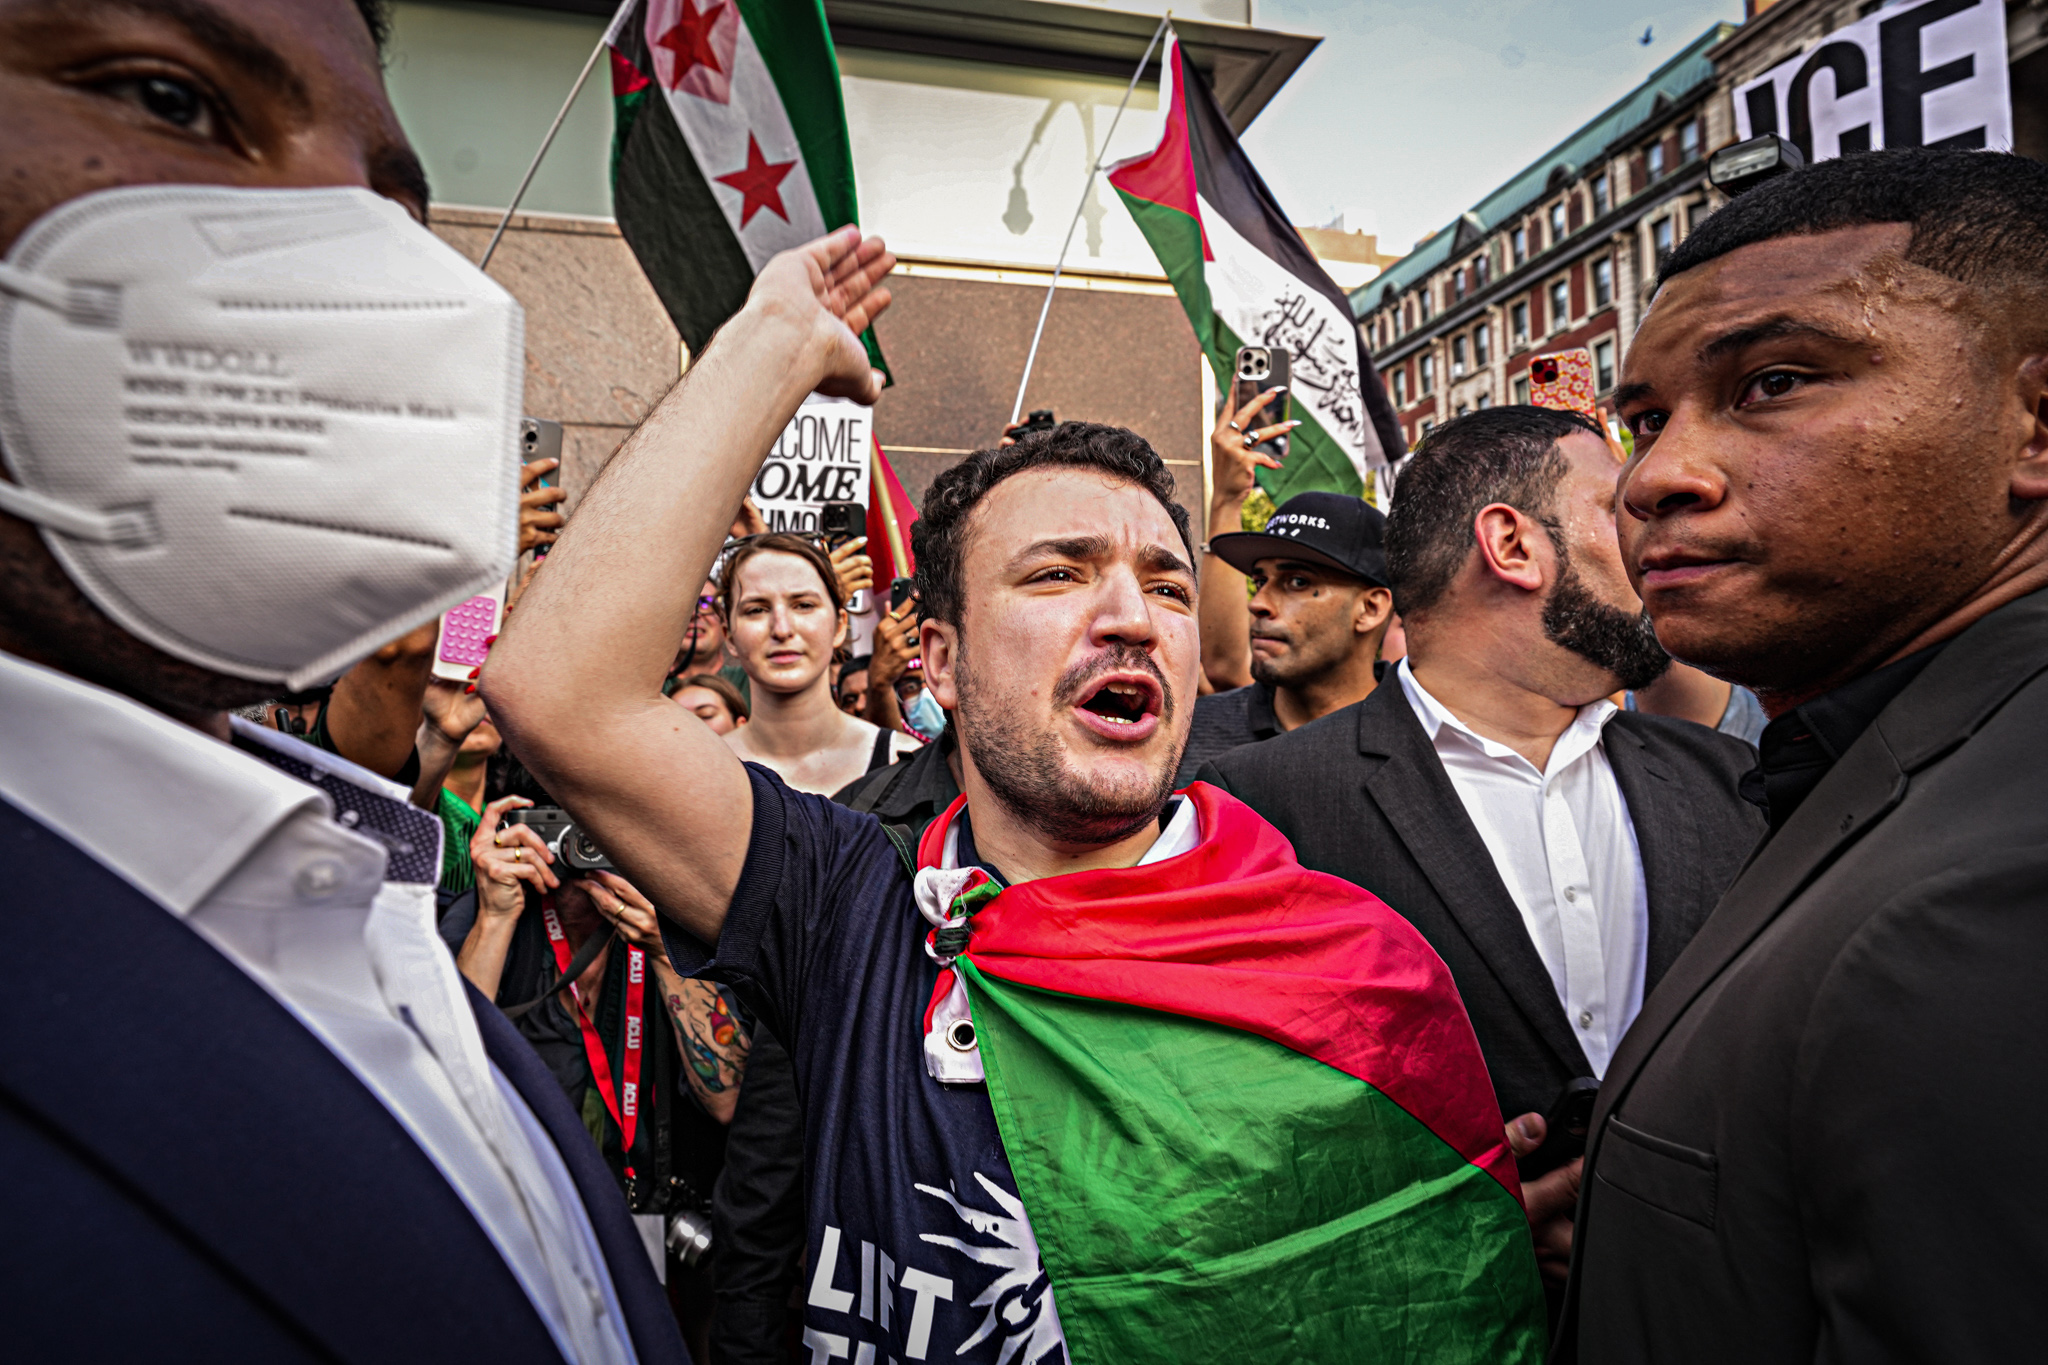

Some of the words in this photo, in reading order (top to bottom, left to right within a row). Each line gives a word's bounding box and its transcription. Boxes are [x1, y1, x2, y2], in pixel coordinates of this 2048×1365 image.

[1745, 0, 1988, 162] ICE
[768, 414, 863, 464] COME
[755, 461, 862, 502] OME
[544, 908, 564, 941] ACLU
[629, 950, 643, 984] ACLU
[627, 1015, 641, 1049] ACLU
[623, 1081, 637, 1116] ACLU
[807, 1225, 954, 1361] LIFT
